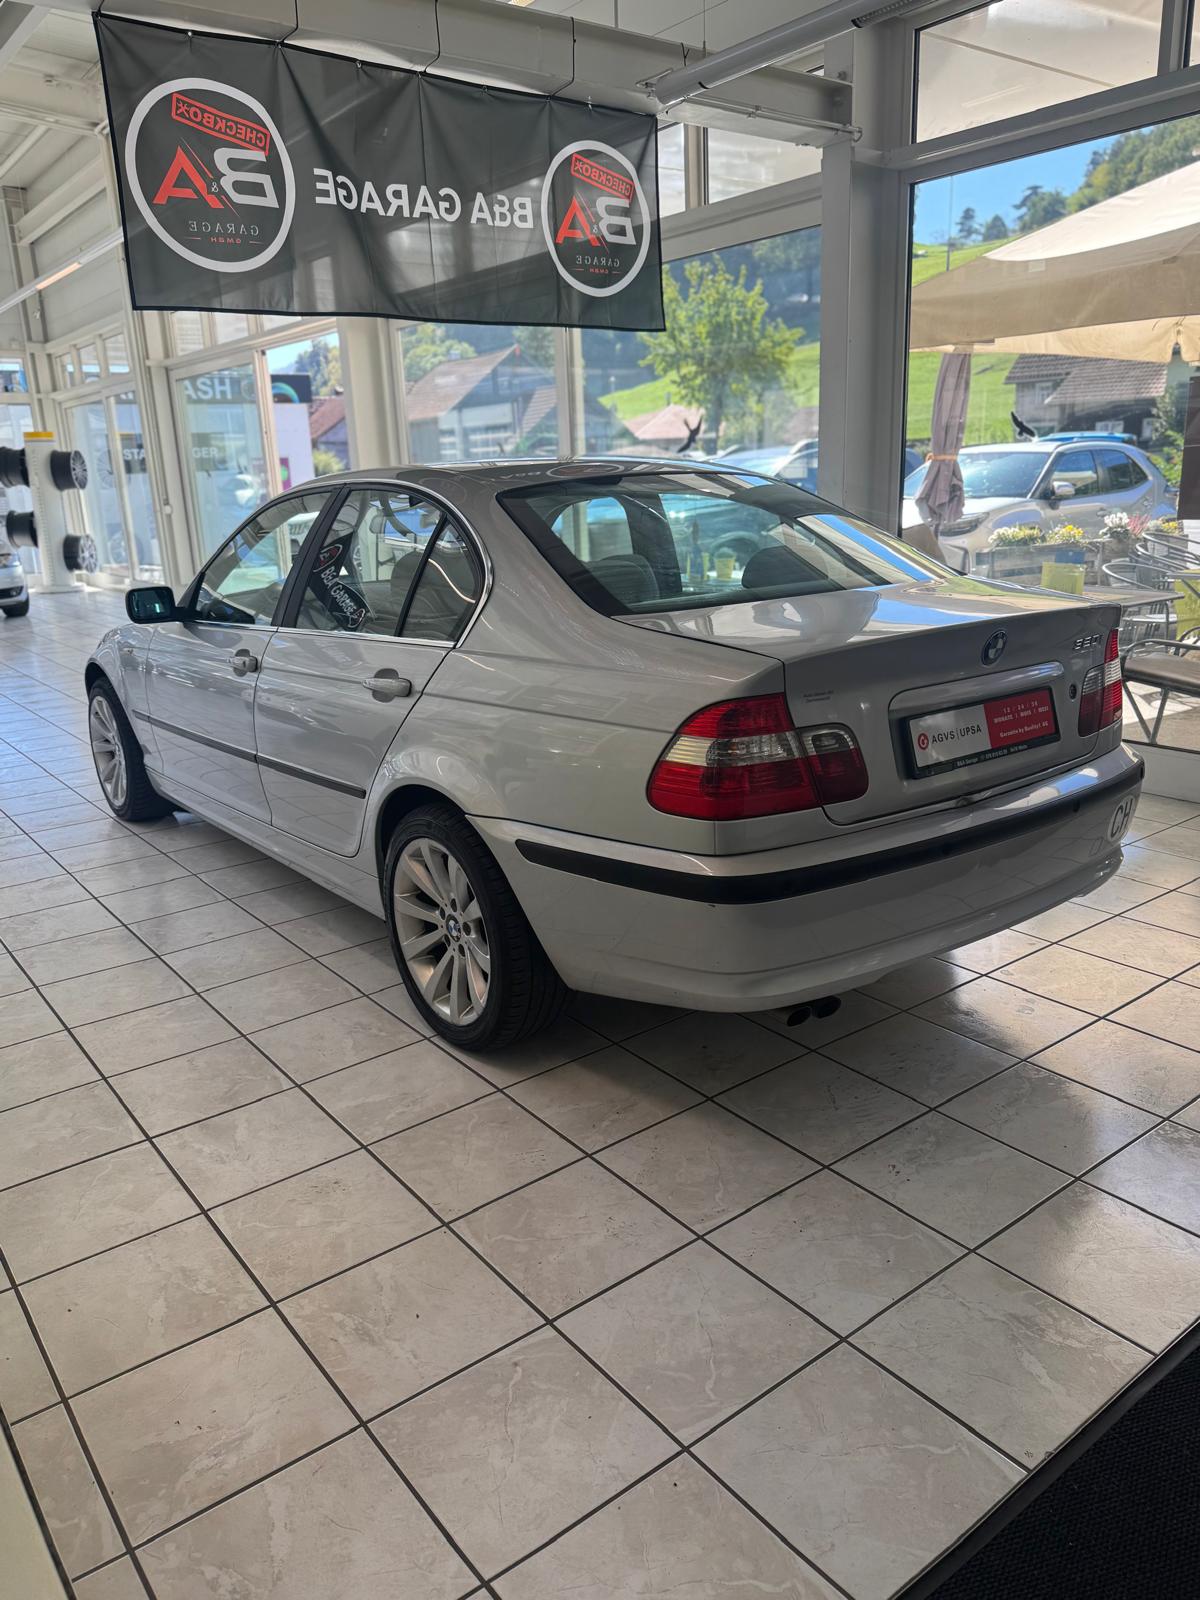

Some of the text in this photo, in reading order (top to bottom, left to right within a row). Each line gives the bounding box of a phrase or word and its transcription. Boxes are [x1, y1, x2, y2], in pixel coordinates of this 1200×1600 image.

[932, 724, 982, 744] AGVS UPSA
[1111, 798, 1134, 839] CH
